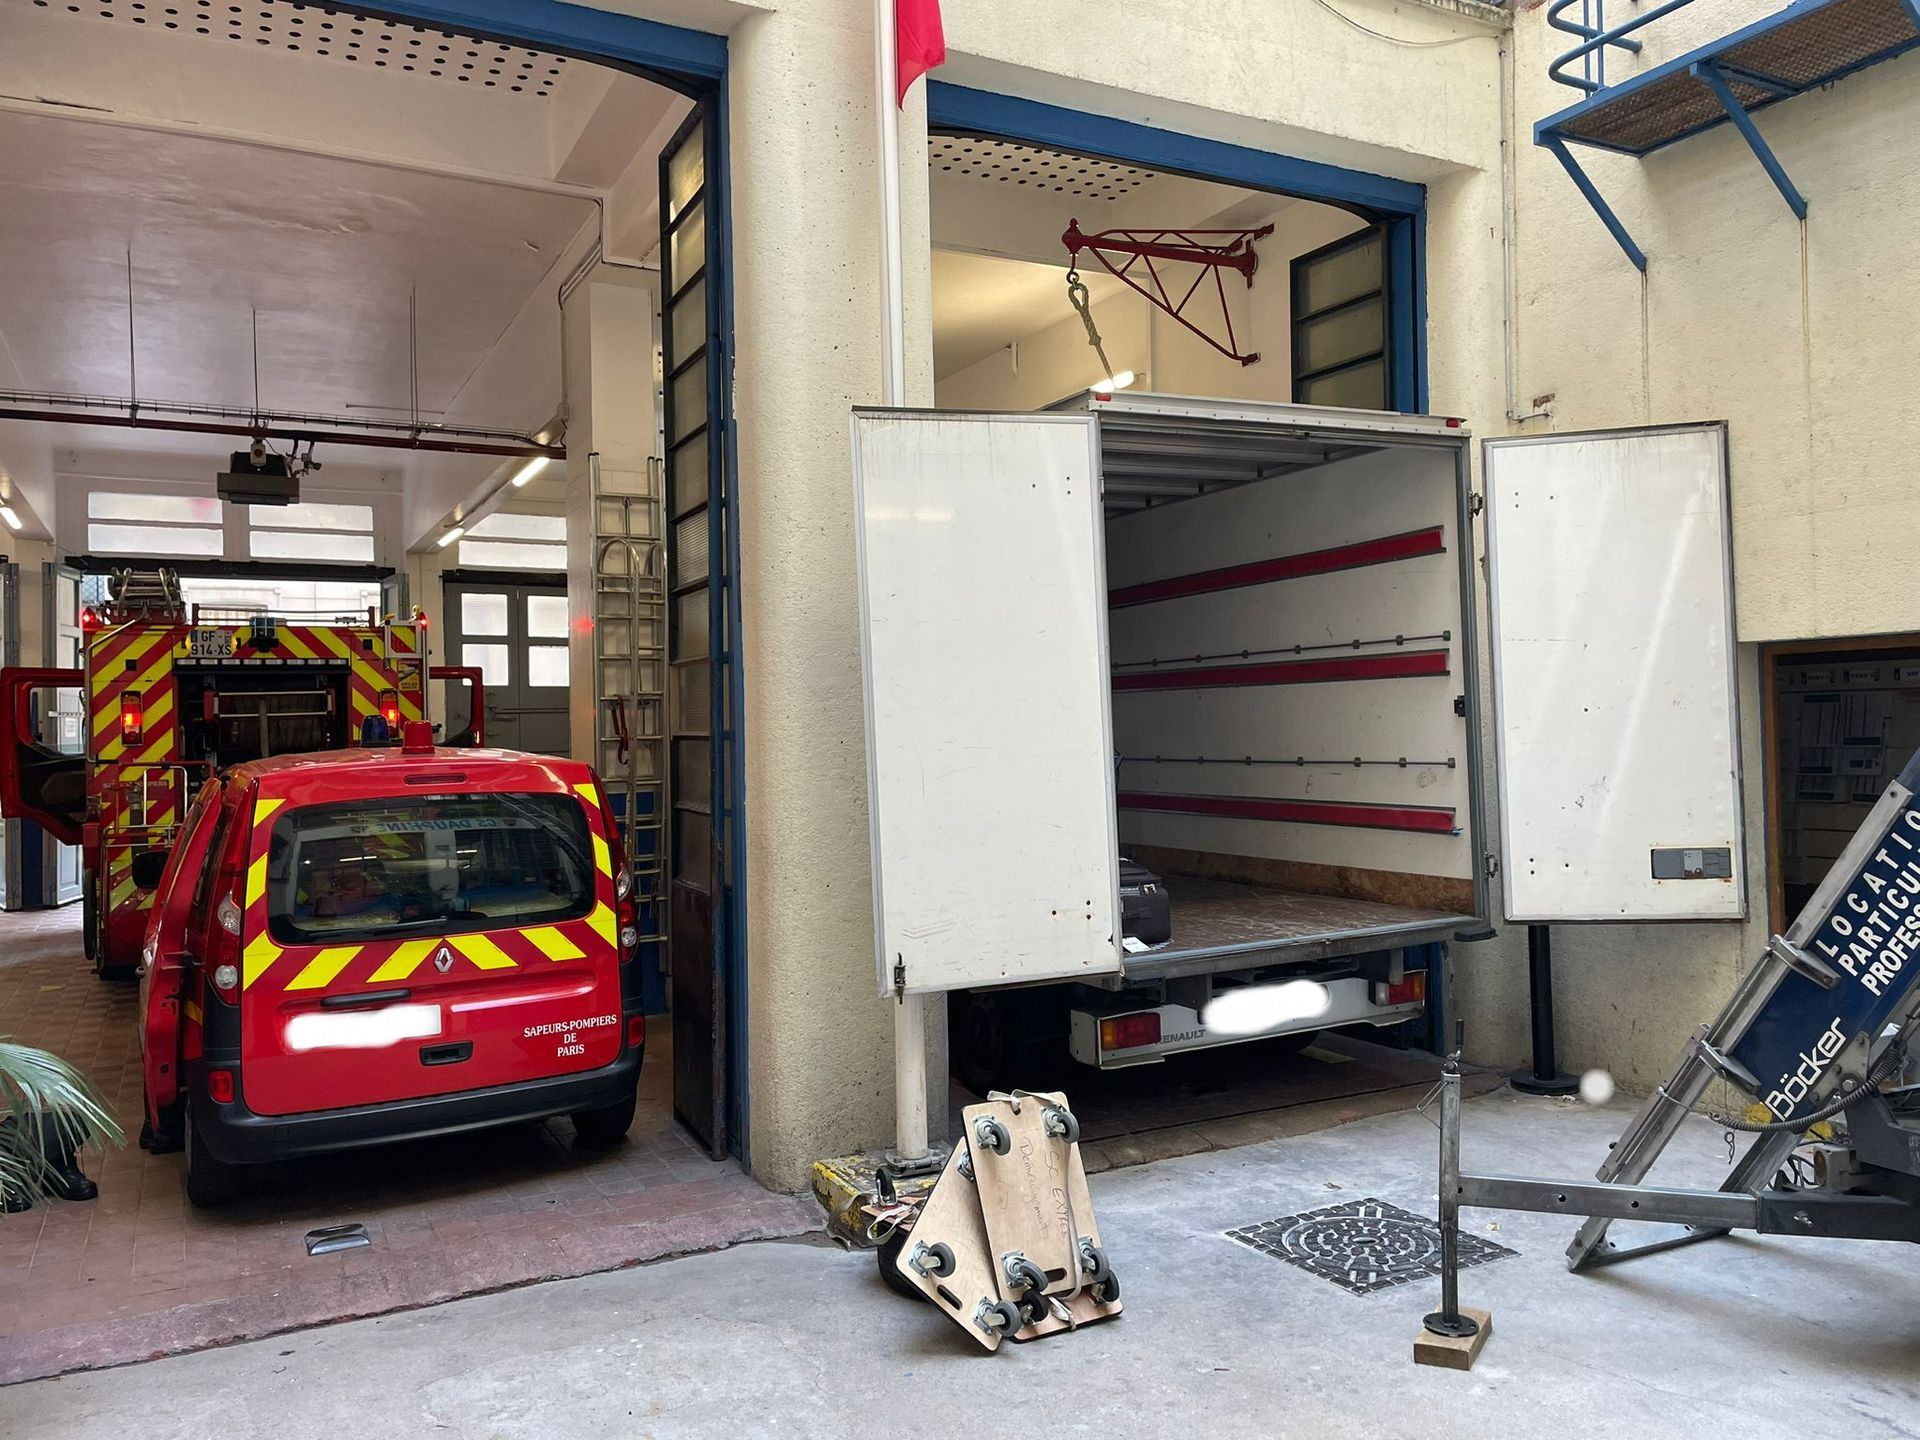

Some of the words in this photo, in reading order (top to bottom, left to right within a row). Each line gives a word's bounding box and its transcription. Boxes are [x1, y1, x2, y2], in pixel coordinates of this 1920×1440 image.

[191, 644, 232, 656] 914-XS
[523, 1014, 618, 1038] SAPEURS-POMPIERS
[563, 1032, 577, 1044] DE
[1161, 1029, 1206, 1043] ENAULT
[557, 1043, 585, 1057] PARIS
[1764, 1016, 1847, 1122] Böcker
